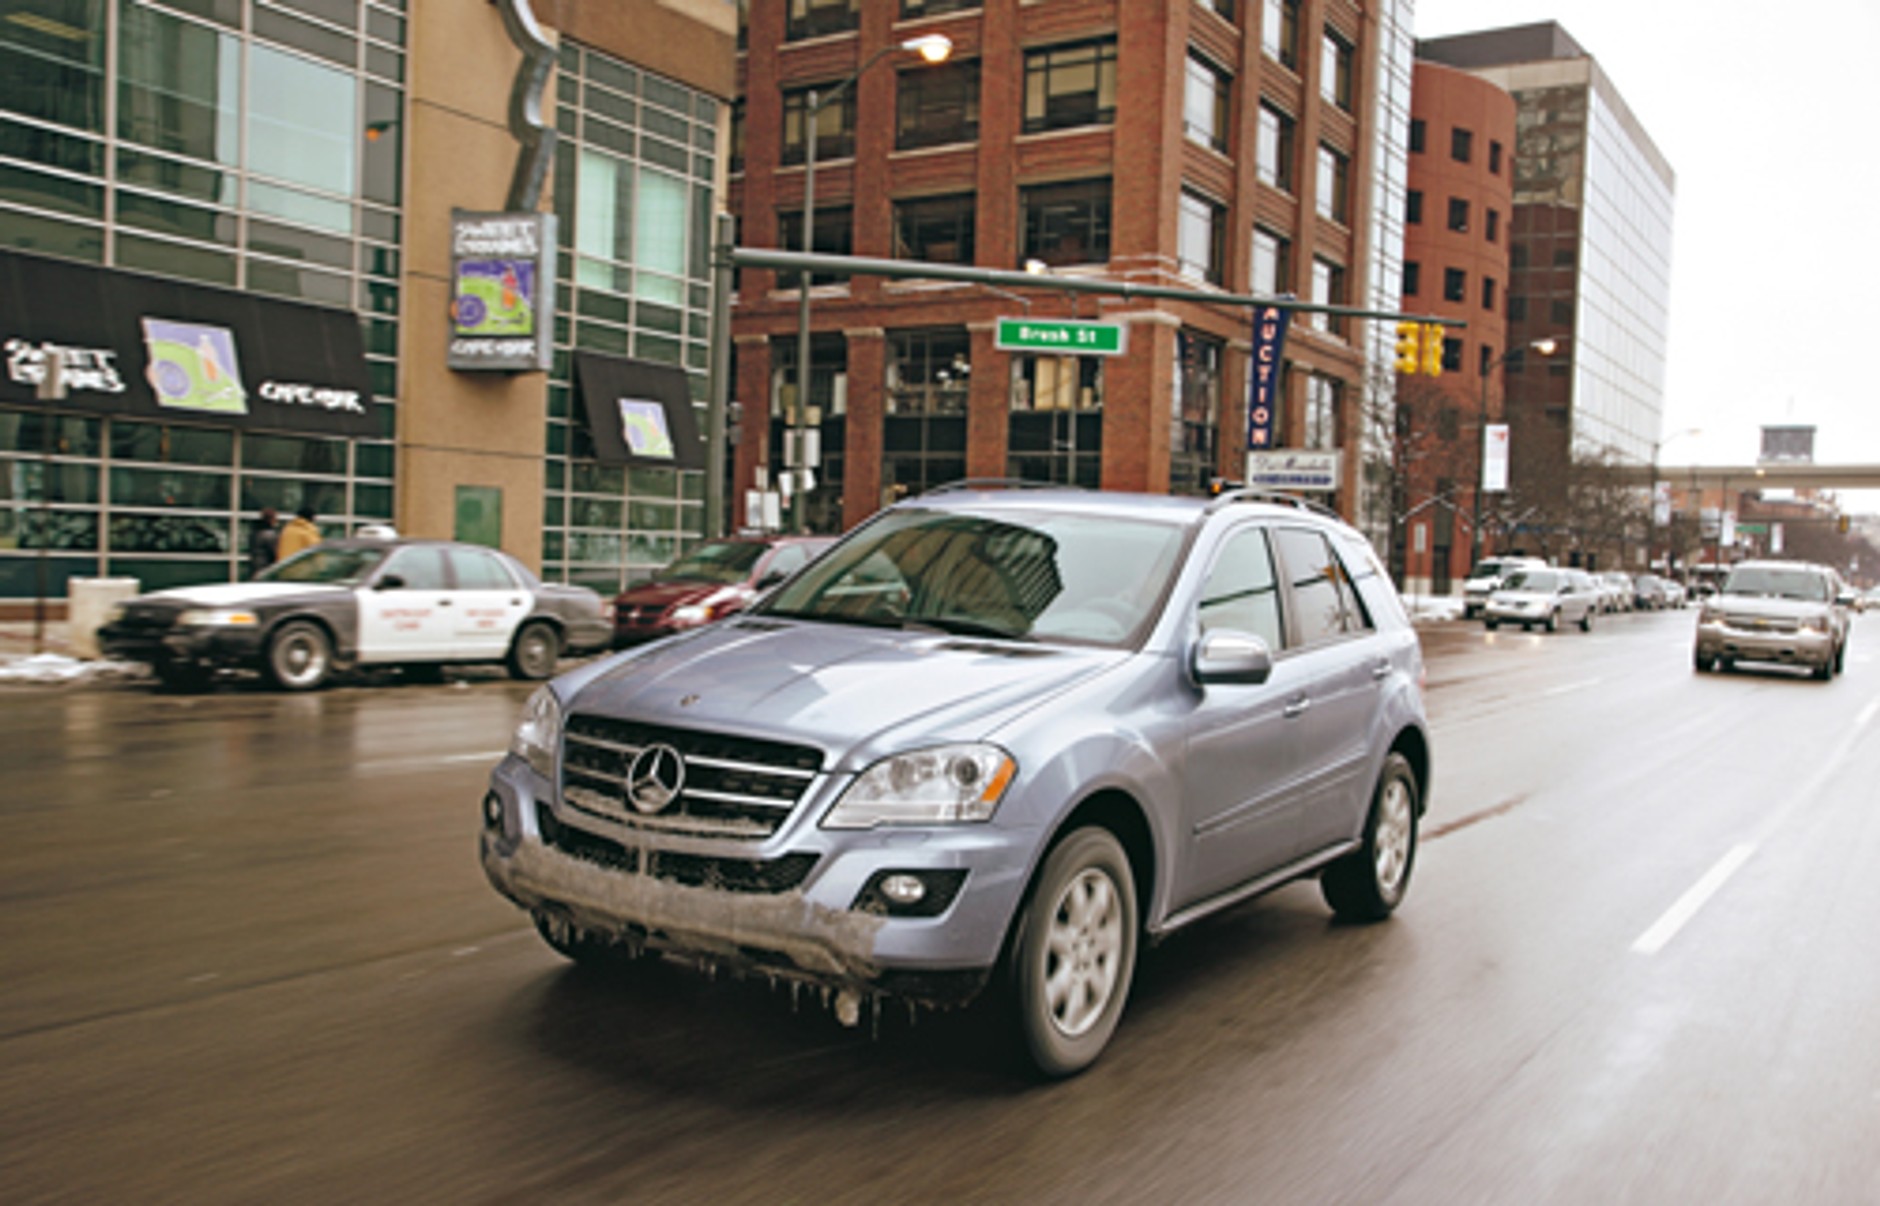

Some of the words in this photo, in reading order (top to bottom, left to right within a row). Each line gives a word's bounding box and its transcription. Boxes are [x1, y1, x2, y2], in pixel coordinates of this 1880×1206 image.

[1018, 326, 1070, 343] Brush
[1077, 329, 1096, 343] St
[1252, 307, 1280, 444] AUCTION
